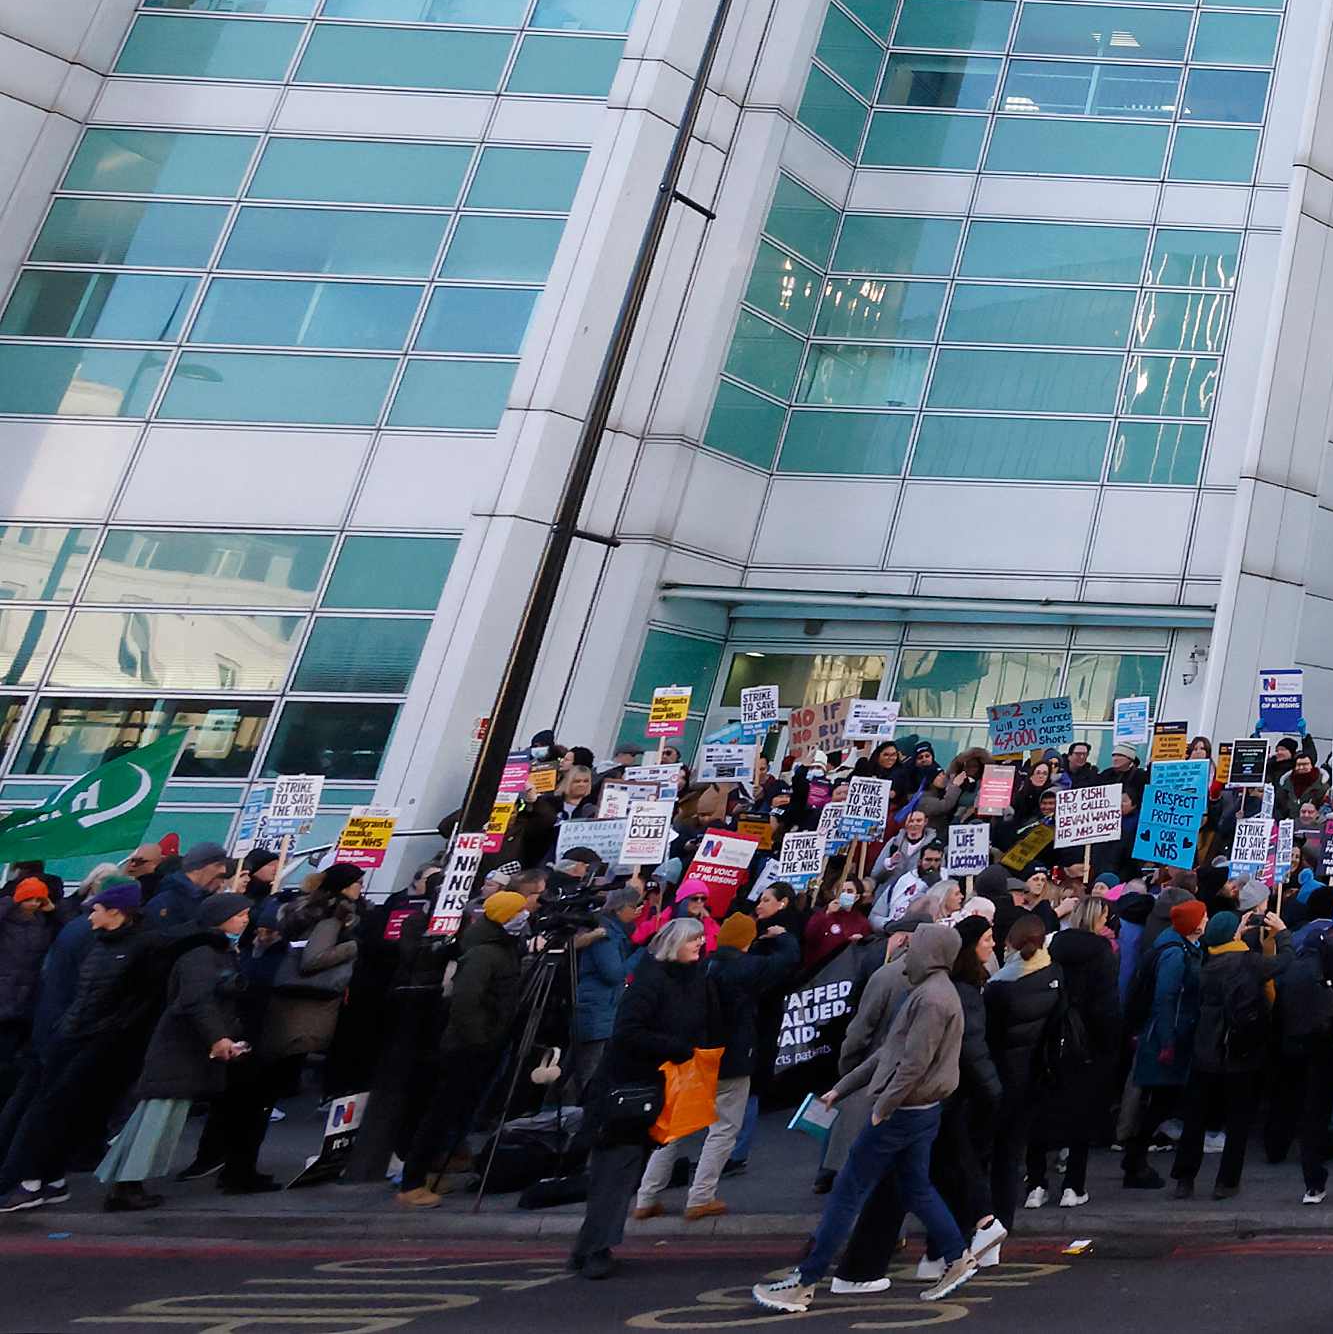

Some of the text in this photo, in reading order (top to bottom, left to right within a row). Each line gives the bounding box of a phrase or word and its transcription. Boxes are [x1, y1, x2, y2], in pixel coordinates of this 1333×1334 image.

[743, 692, 772, 703] STRIKE
[743, 702, 776, 714] TO SAVE
[1011, 701, 1068, 716] 2 of us
[743, 711, 777, 722] THE NHS
[791, 709, 815, 728] NO
[823, 702, 841, 720] IF
[995, 721, 1013, 732] will
[1018, 716, 1037, 730] get
[1039, 724, 1071, 734] nurses
[277, 782, 313, 793] STRIKE
[850, 782, 882, 795] STRIKE
[275, 794, 315, 805] TO SAVE
[849, 795, 883, 808] TO SAVE
[1058, 787, 1106, 804] HEY RISHI
[1154, 790, 1198, 809] RESPECT
[272, 806, 315, 816] THE NHS
[846, 804, 882, 818] THE NHS
[1058, 804, 1077, 815] 1948
[1059, 809, 1121, 827] BEVAN WANTS
[1151, 809, 1193, 826] PROTECT
[349, 818, 393, 832] Migrants
[1057, 820, 1119, 839] HIS NHS BACK!
[1237, 824, 1264, 836] STRIKE
[630, 826, 663, 838] OUT!
[1159, 830, 1178, 842] OUR
[253, 839, 273, 850] THE
[361, 838, 383, 847] NHS
[784, 838, 816, 850] STRIKE
[956, 834, 975, 847] LIFE
[1236, 836, 1266, 848] TO SAVE
[782, 850, 820, 862] TO SAVE
[1153, 842, 1178, 860] NHS
[1234, 849, 1265, 861] THE NHS
[697, 865, 738, 876] THE VOICE
[781, 861, 820, 874] THE NHS
